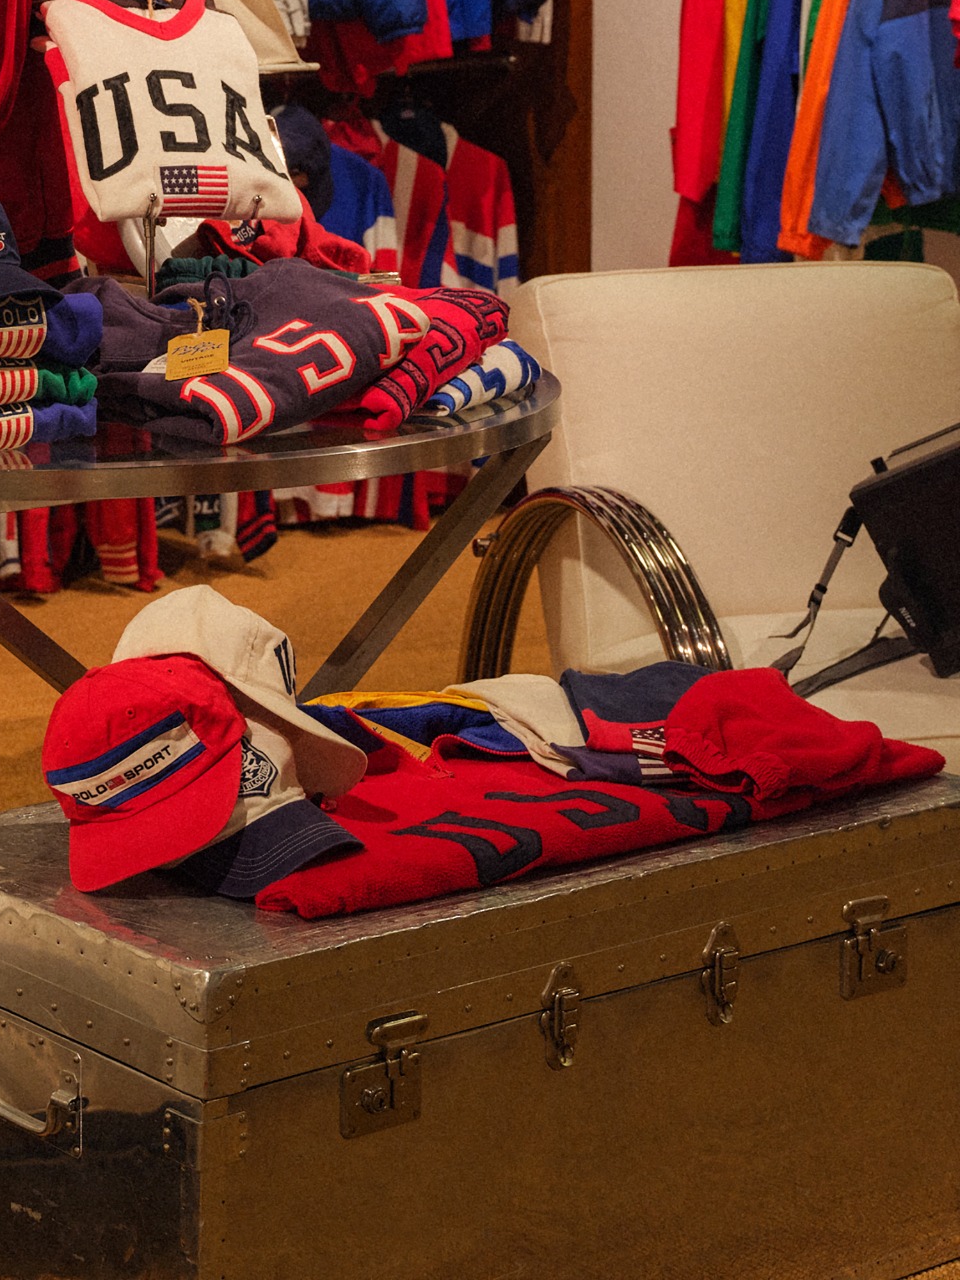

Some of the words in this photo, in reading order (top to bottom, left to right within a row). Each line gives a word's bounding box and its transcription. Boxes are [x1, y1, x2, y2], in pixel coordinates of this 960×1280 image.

[76, 69, 289, 182] USA
[237, 225, 255, 242] USA
[181, 292, 431, 446] USA
[71, 783, 108, 801] POLO
[124, 745, 171, 781] SPORT
